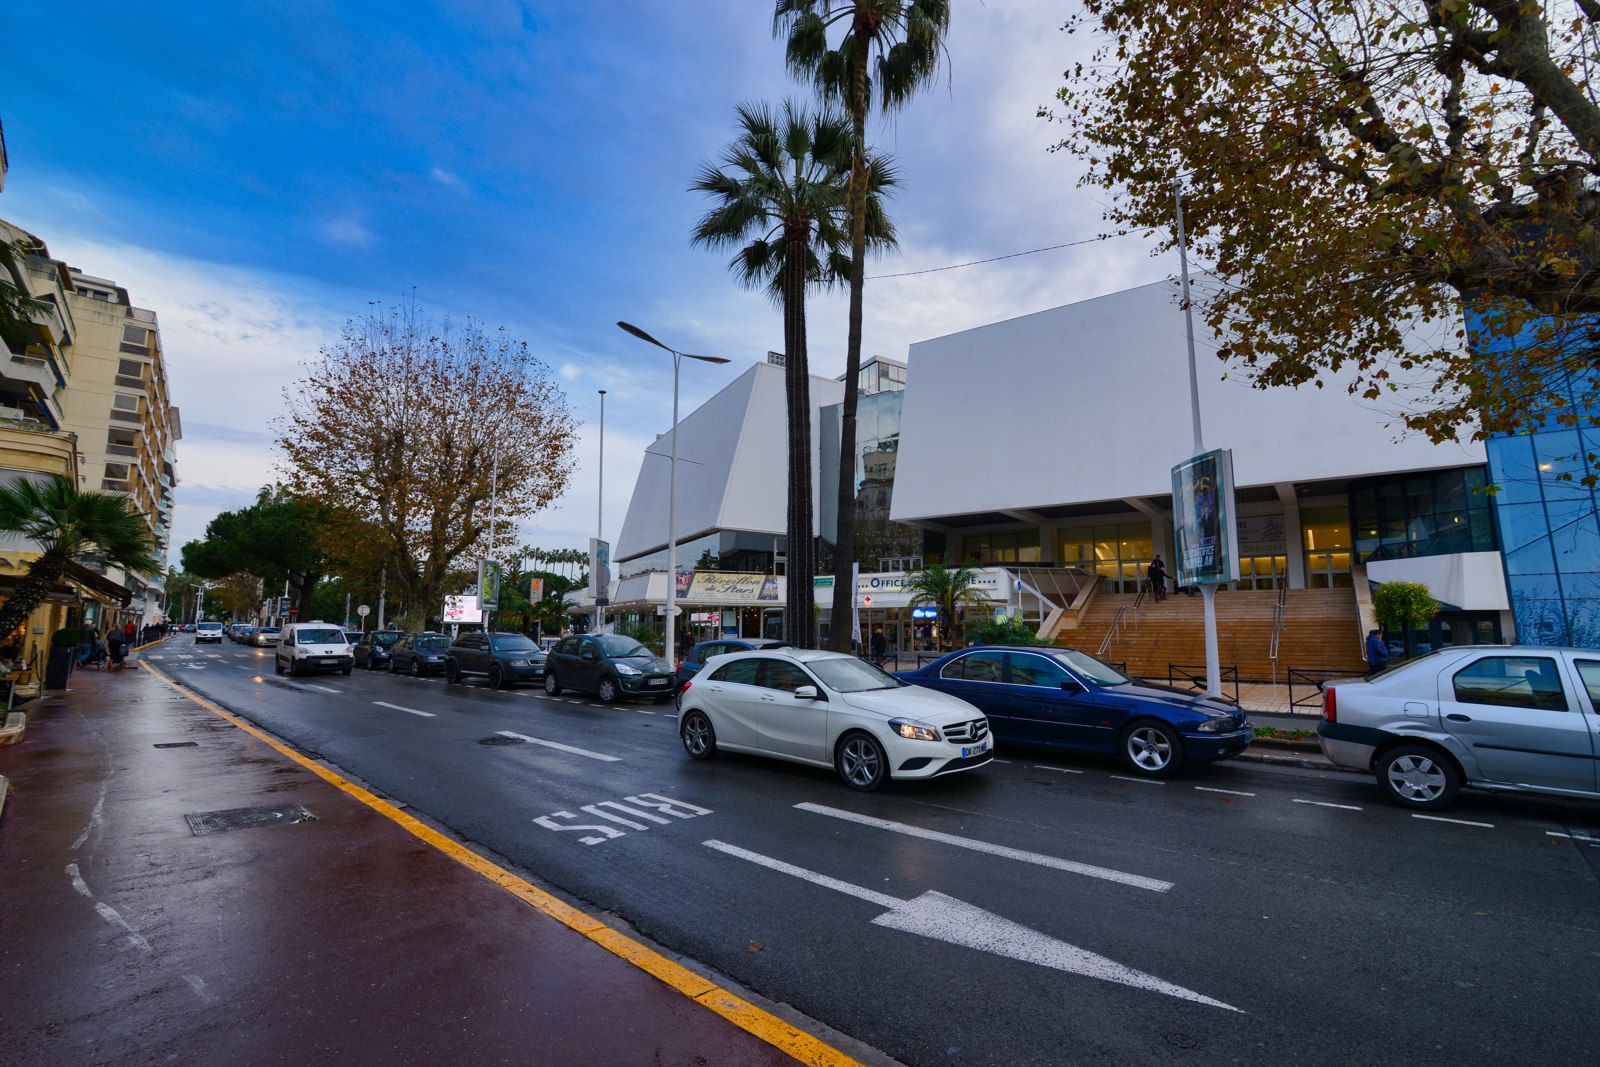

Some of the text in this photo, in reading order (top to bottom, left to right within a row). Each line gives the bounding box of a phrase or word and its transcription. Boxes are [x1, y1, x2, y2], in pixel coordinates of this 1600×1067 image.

[870, 577, 905, 588] OFFICE
[717, 583, 754, 594] Stars
[532, 792, 716, 846] BUS
